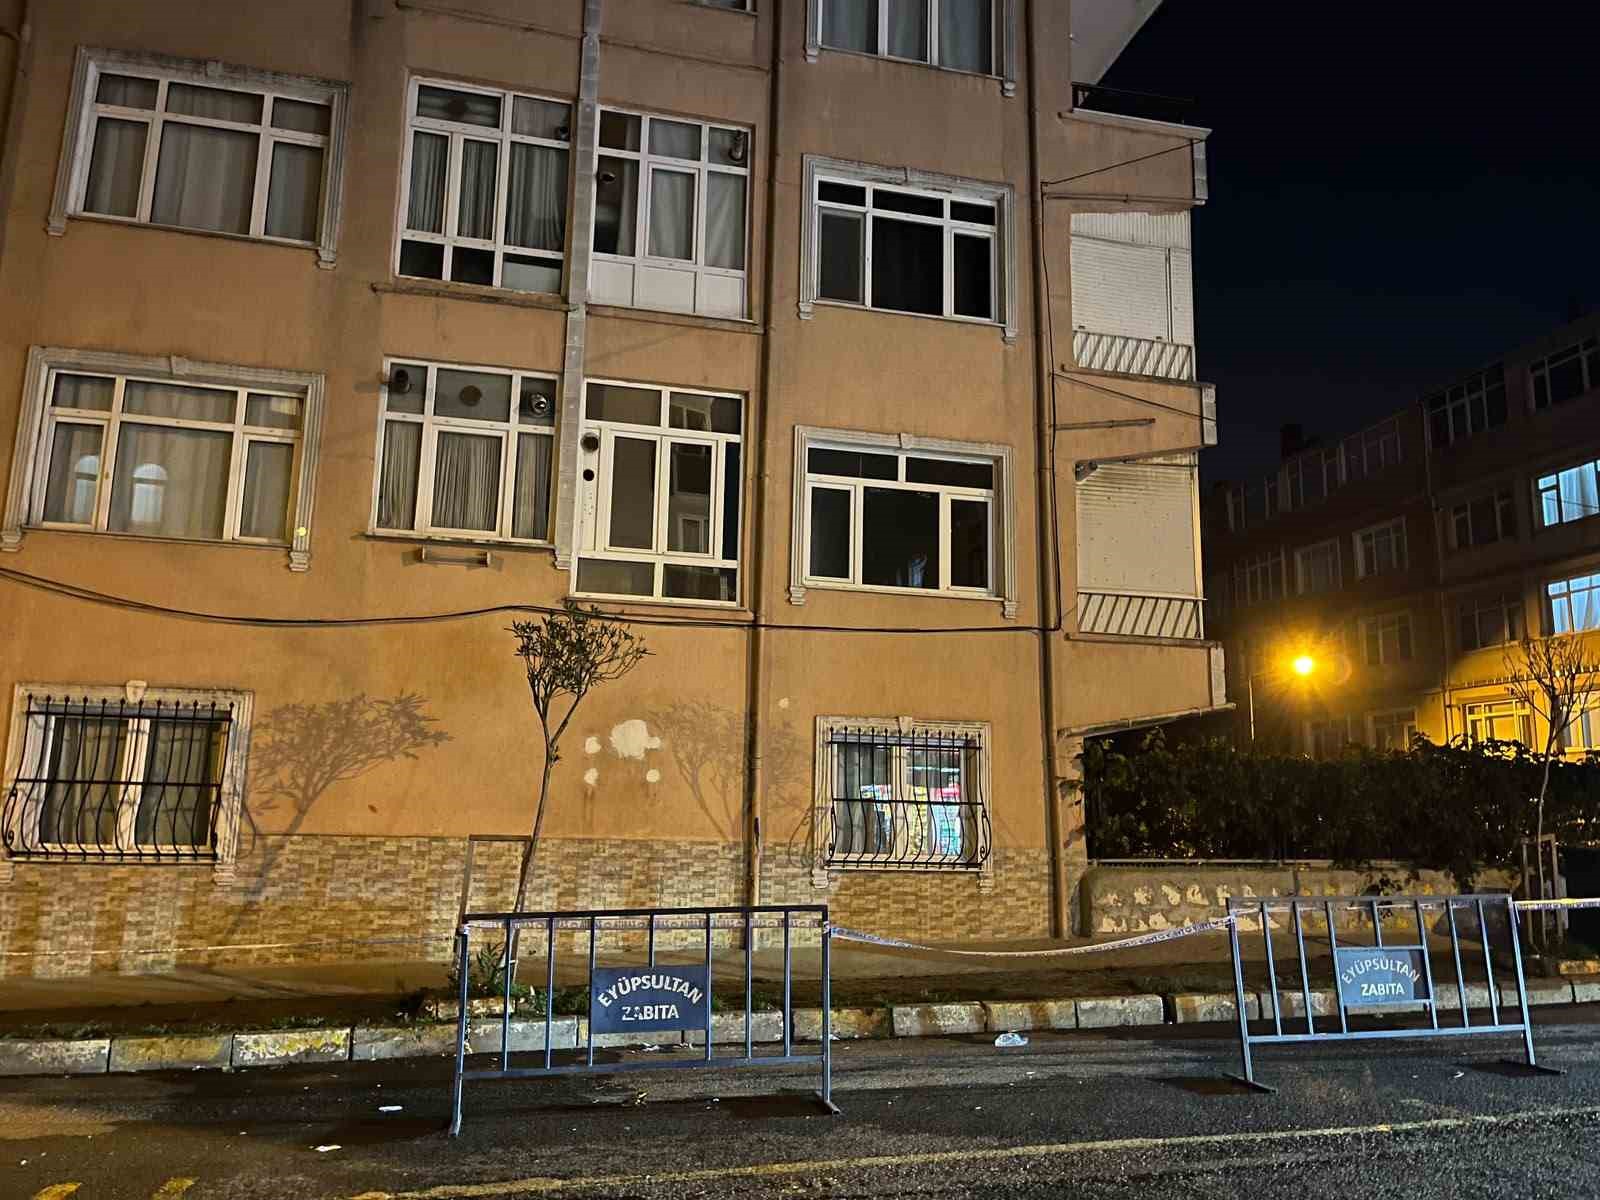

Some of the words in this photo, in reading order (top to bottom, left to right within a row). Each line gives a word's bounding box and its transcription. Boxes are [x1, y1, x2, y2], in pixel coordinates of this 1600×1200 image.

[1342, 957, 1420, 984] EYÜPSULTAN
[598, 974, 702, 1007] EYÜPSULTAN
[1361, 982, 1405, 996] ZABITA
[621, 1004, 680, 1021] ZABITA
